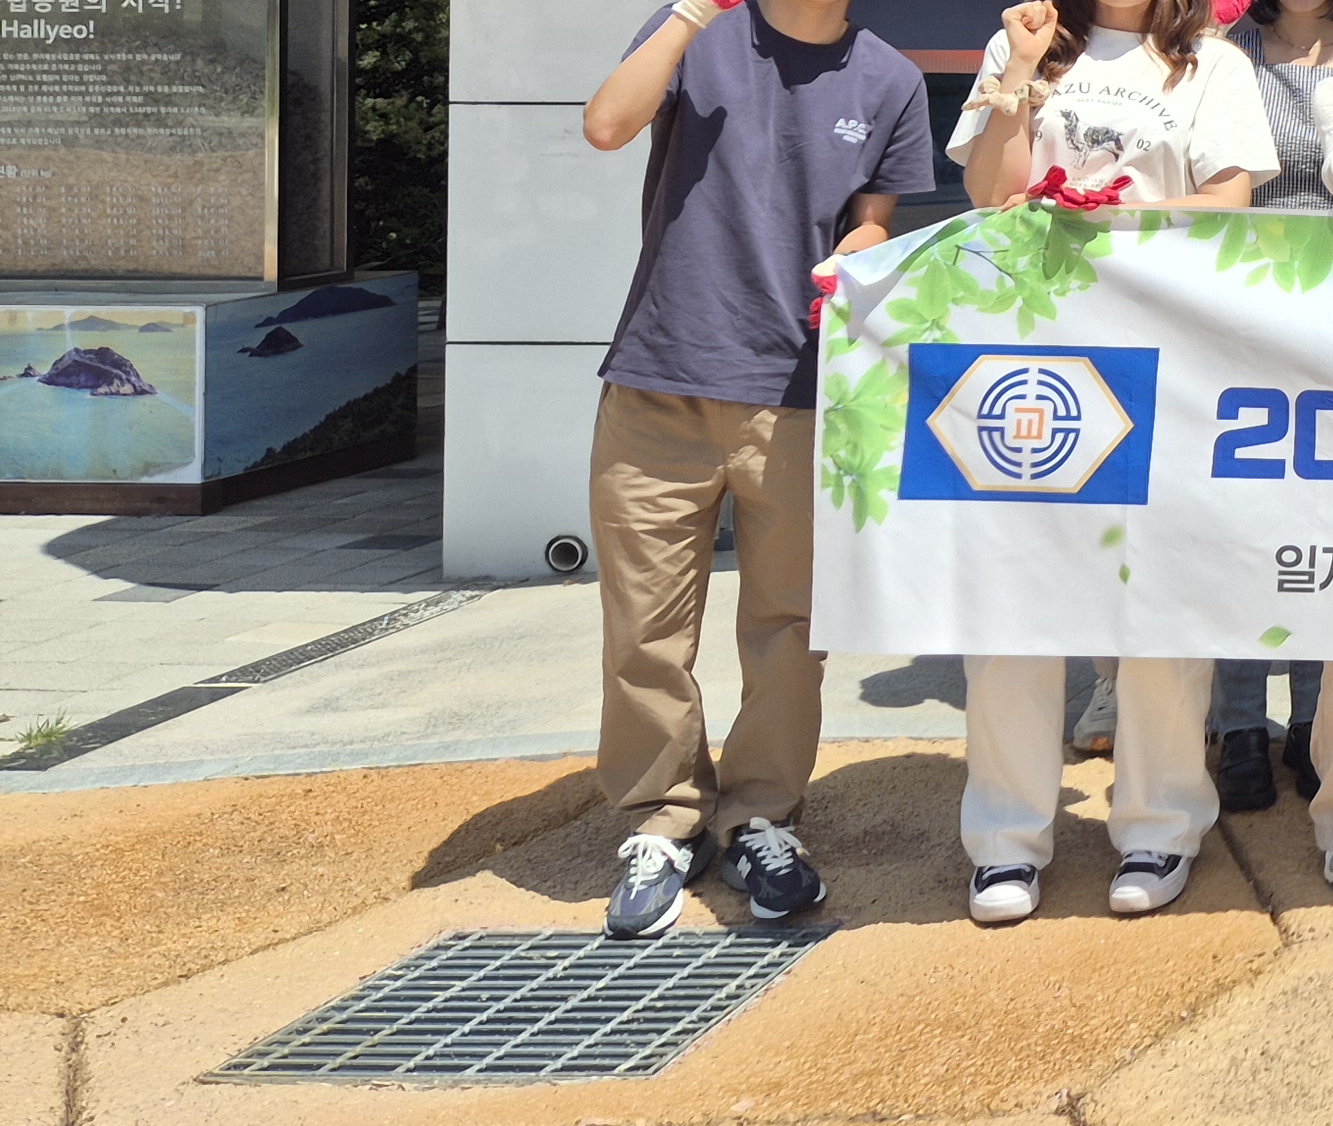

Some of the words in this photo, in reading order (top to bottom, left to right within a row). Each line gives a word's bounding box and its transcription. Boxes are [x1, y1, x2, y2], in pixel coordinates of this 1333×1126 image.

[1, 19, 95, 44] Hallyeo!
[1099, 85, 1177, 131] ARCHIVE
[1136, 138, 1151, 151] 02
